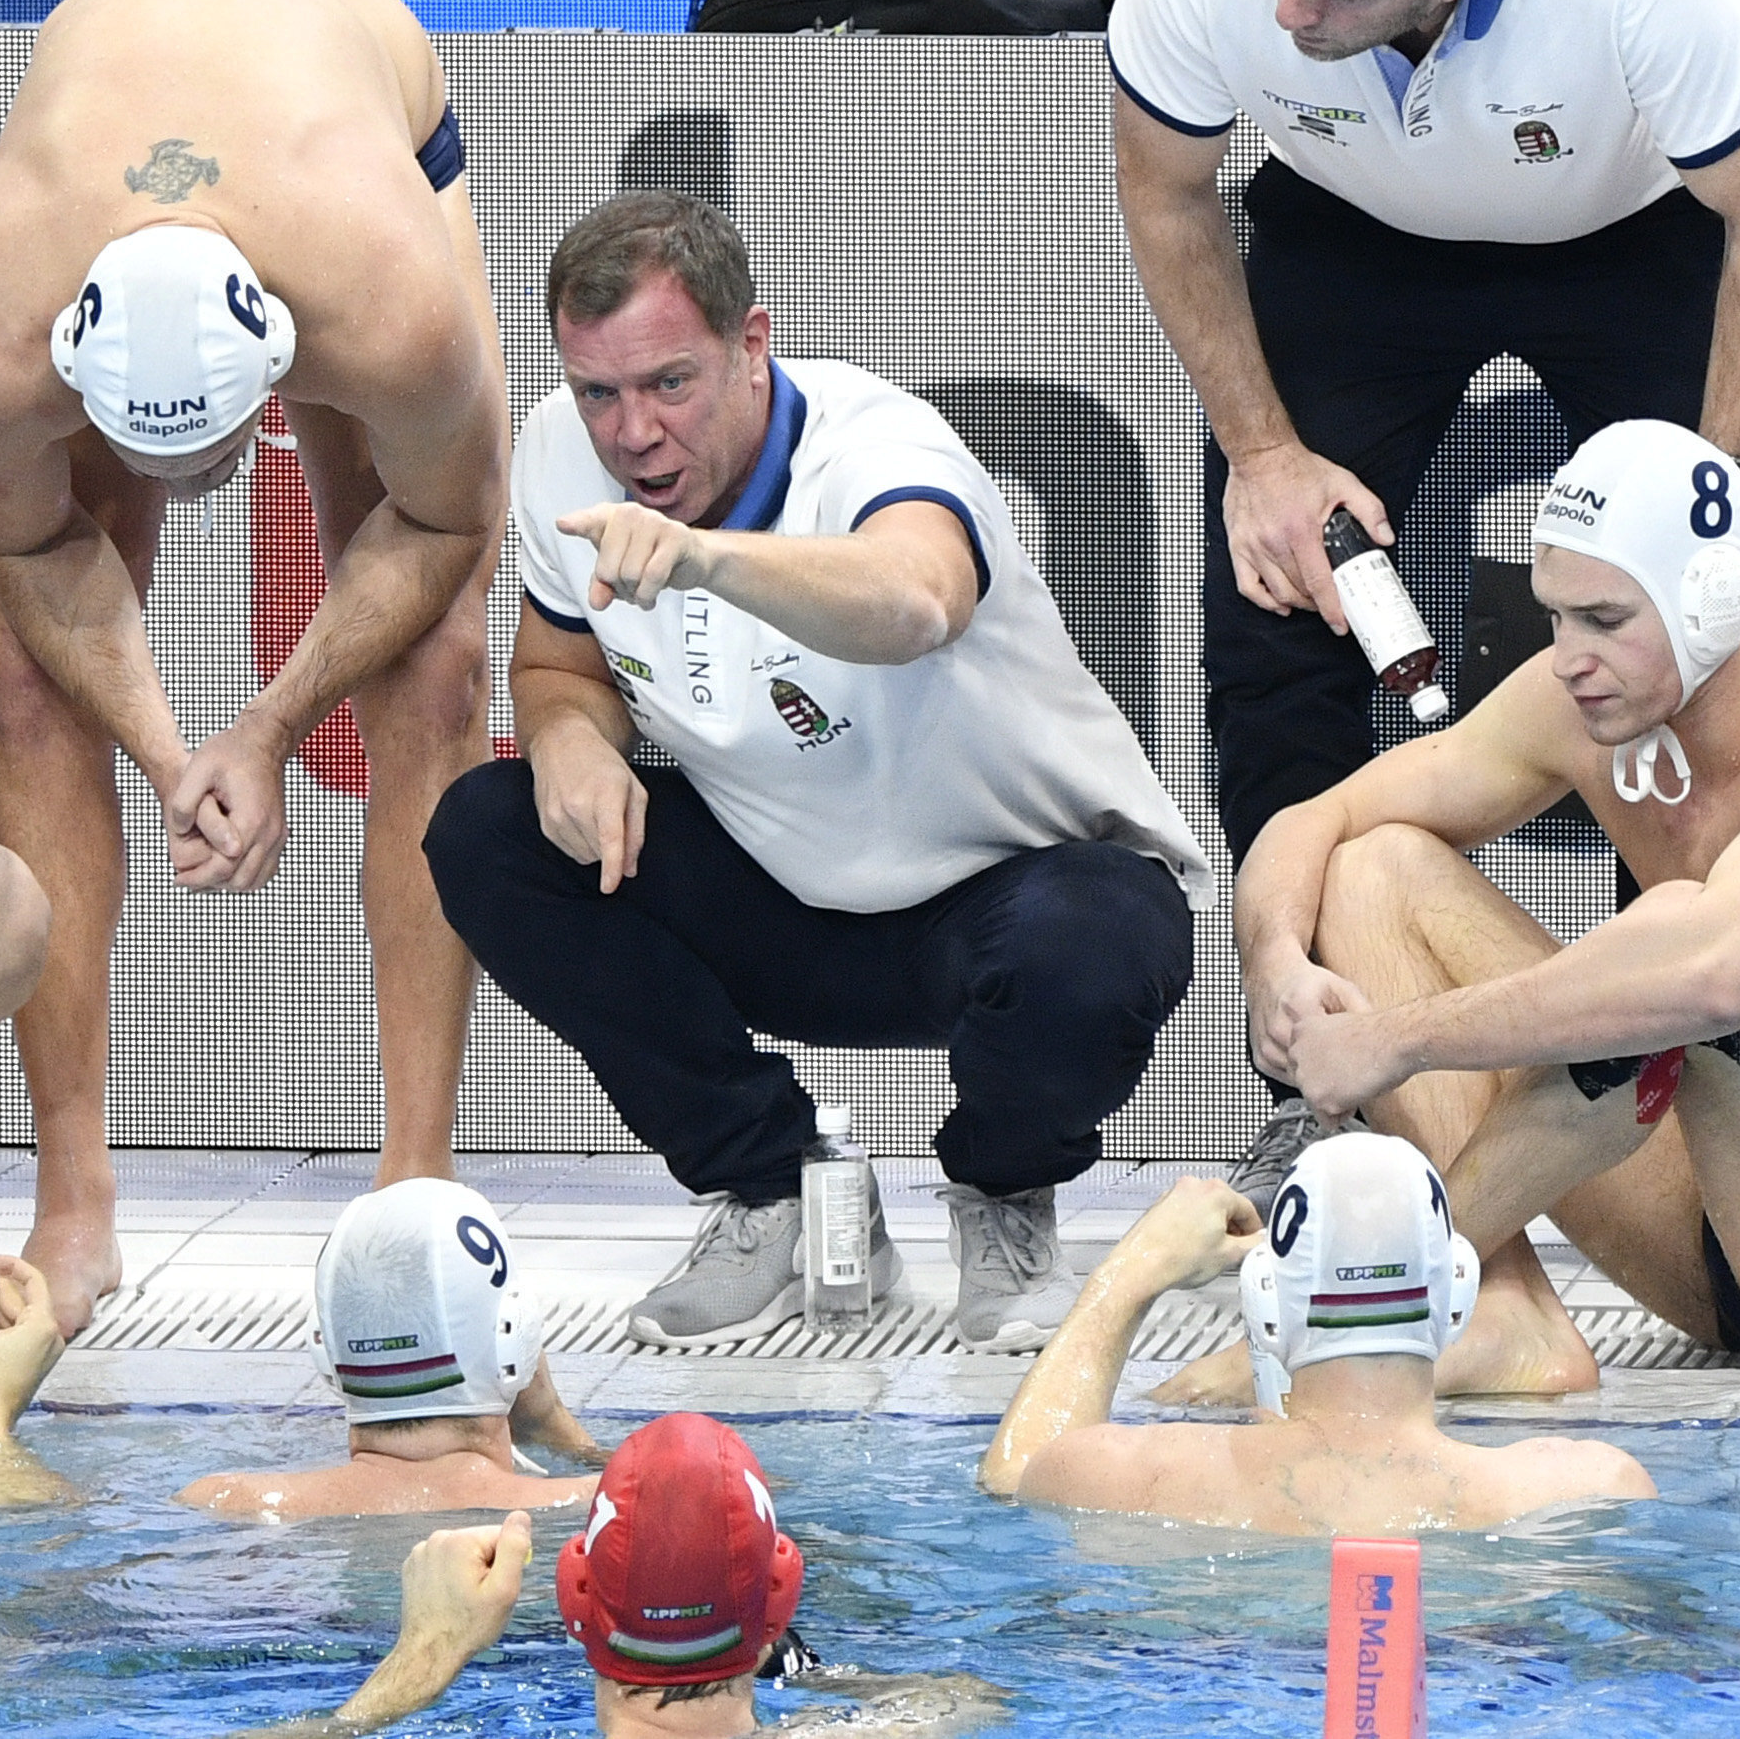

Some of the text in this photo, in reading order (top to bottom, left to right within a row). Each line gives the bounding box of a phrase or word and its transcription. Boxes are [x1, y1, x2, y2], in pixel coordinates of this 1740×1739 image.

[225, 272, 268, 341] 6
[126, 395, 208, 419] HUN
[128, 417, 209, 438] diapolo
[1689, 460, 1734, 540] 8
[794, 715, 853, 753] HUN
[1270, 1163, 1309, 1259] 0
[455, 1214, 509, 1289] 9
